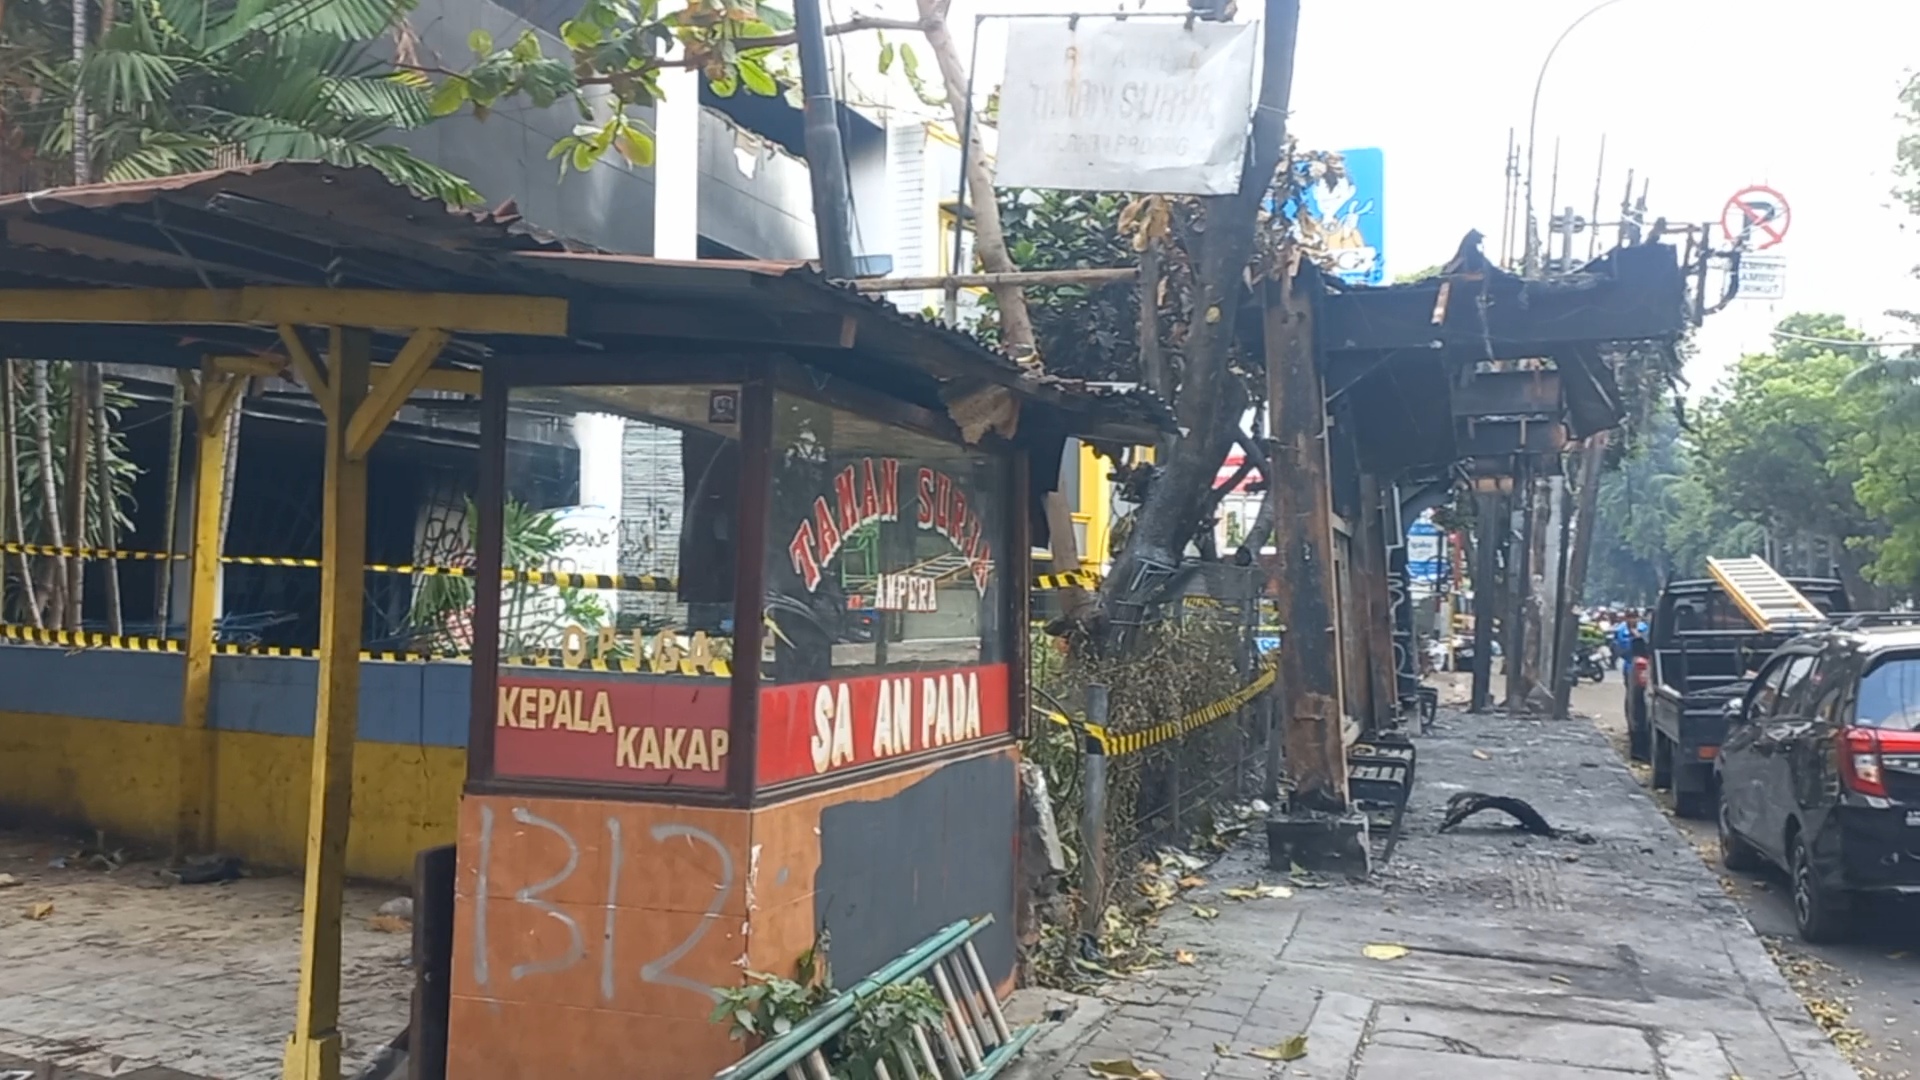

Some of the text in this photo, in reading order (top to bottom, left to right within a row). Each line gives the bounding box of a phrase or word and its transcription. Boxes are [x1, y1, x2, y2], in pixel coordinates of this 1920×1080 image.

[788, 456, 898, 593] TAMAN
[917, 467, 991, 598] SURYA
[874, 573, 938, 613] AMPERA
[497, 685, 614, 734] KEPALA
[921, 671, 981, 749] PADA
[616, 725, 730, 772] KAKAP
